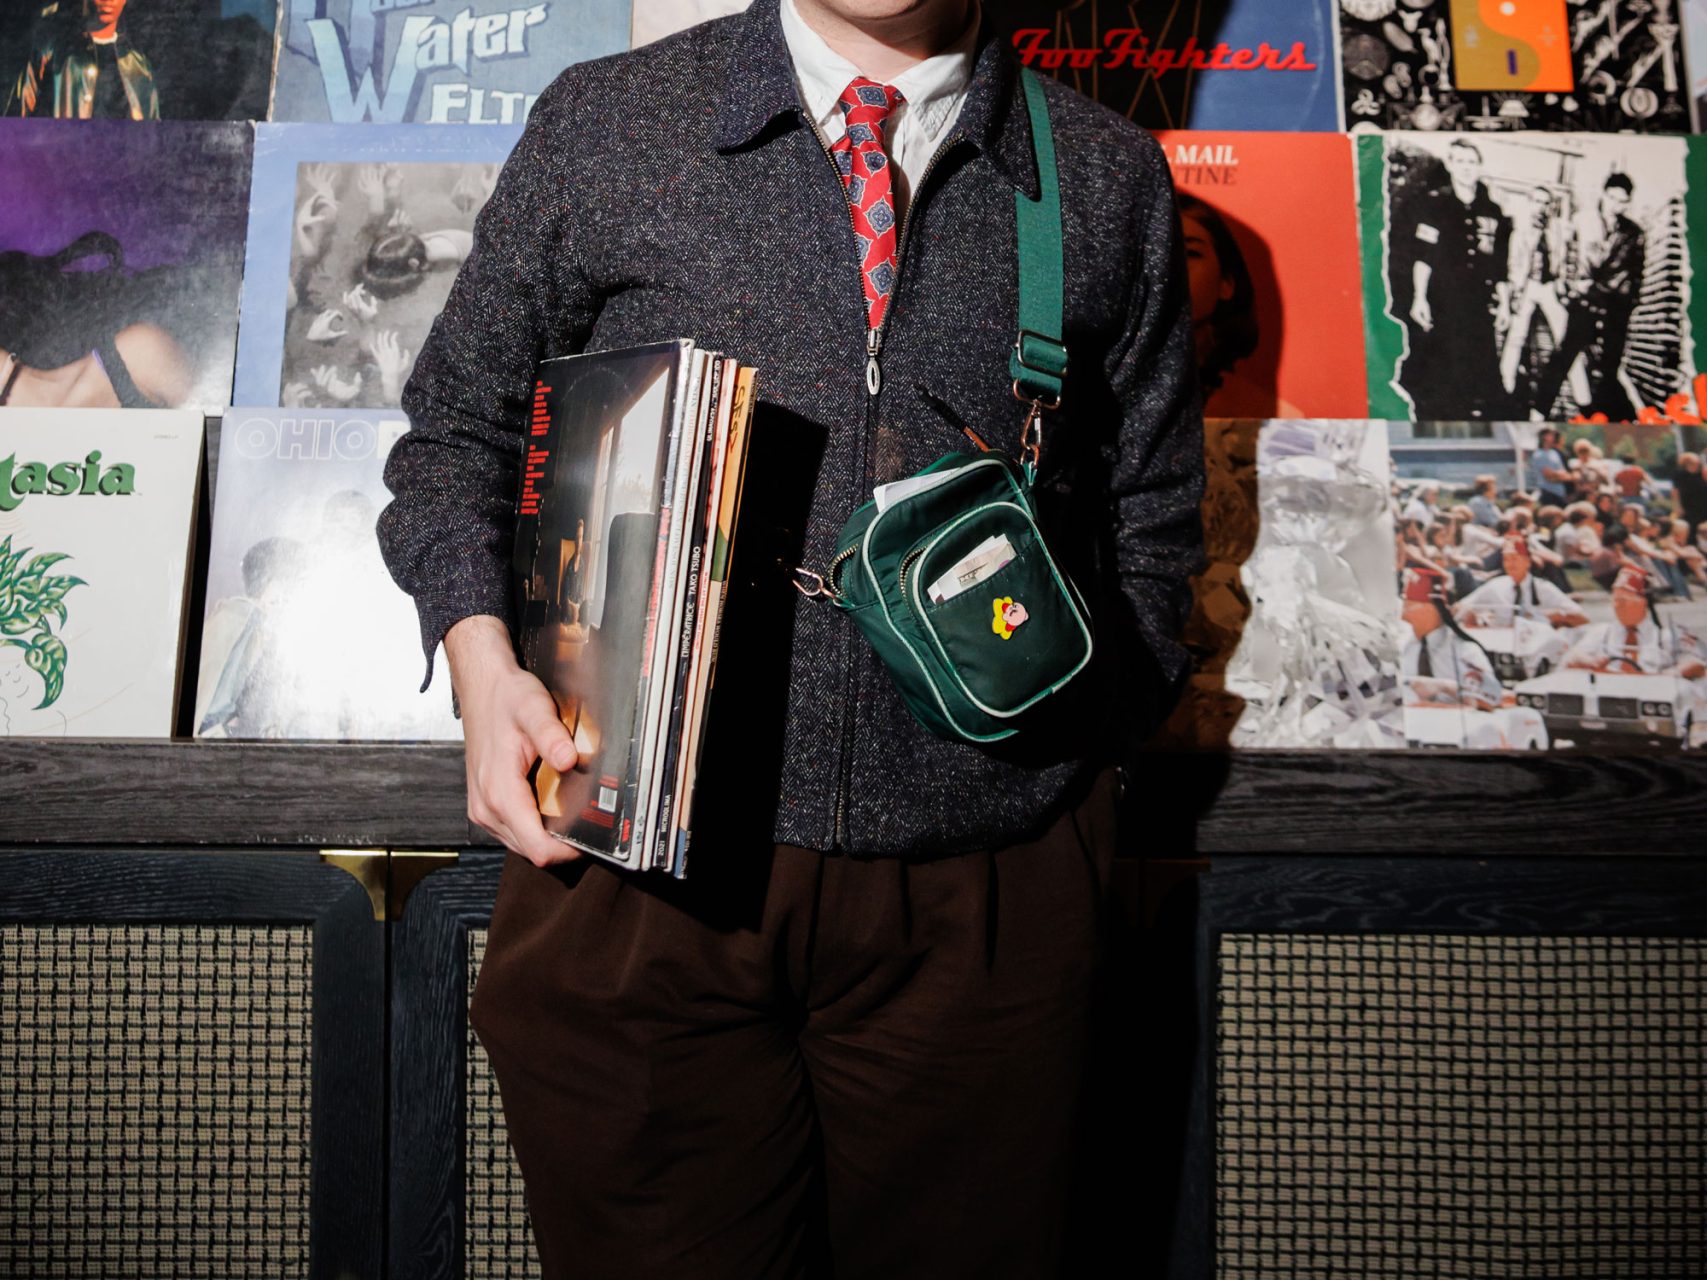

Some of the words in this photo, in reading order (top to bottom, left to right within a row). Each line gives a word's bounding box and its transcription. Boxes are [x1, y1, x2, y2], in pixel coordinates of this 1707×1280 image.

[307, 0, 547, 123] Water
[1011, 27, 1103, 69] Foo
[1103, 27, 1317, 80] Fighters
[1175, 144, 1240, 166] MAIL
[690, 546, 701, 572] TSUBO
[688, 574, 699, 596] TAKO
